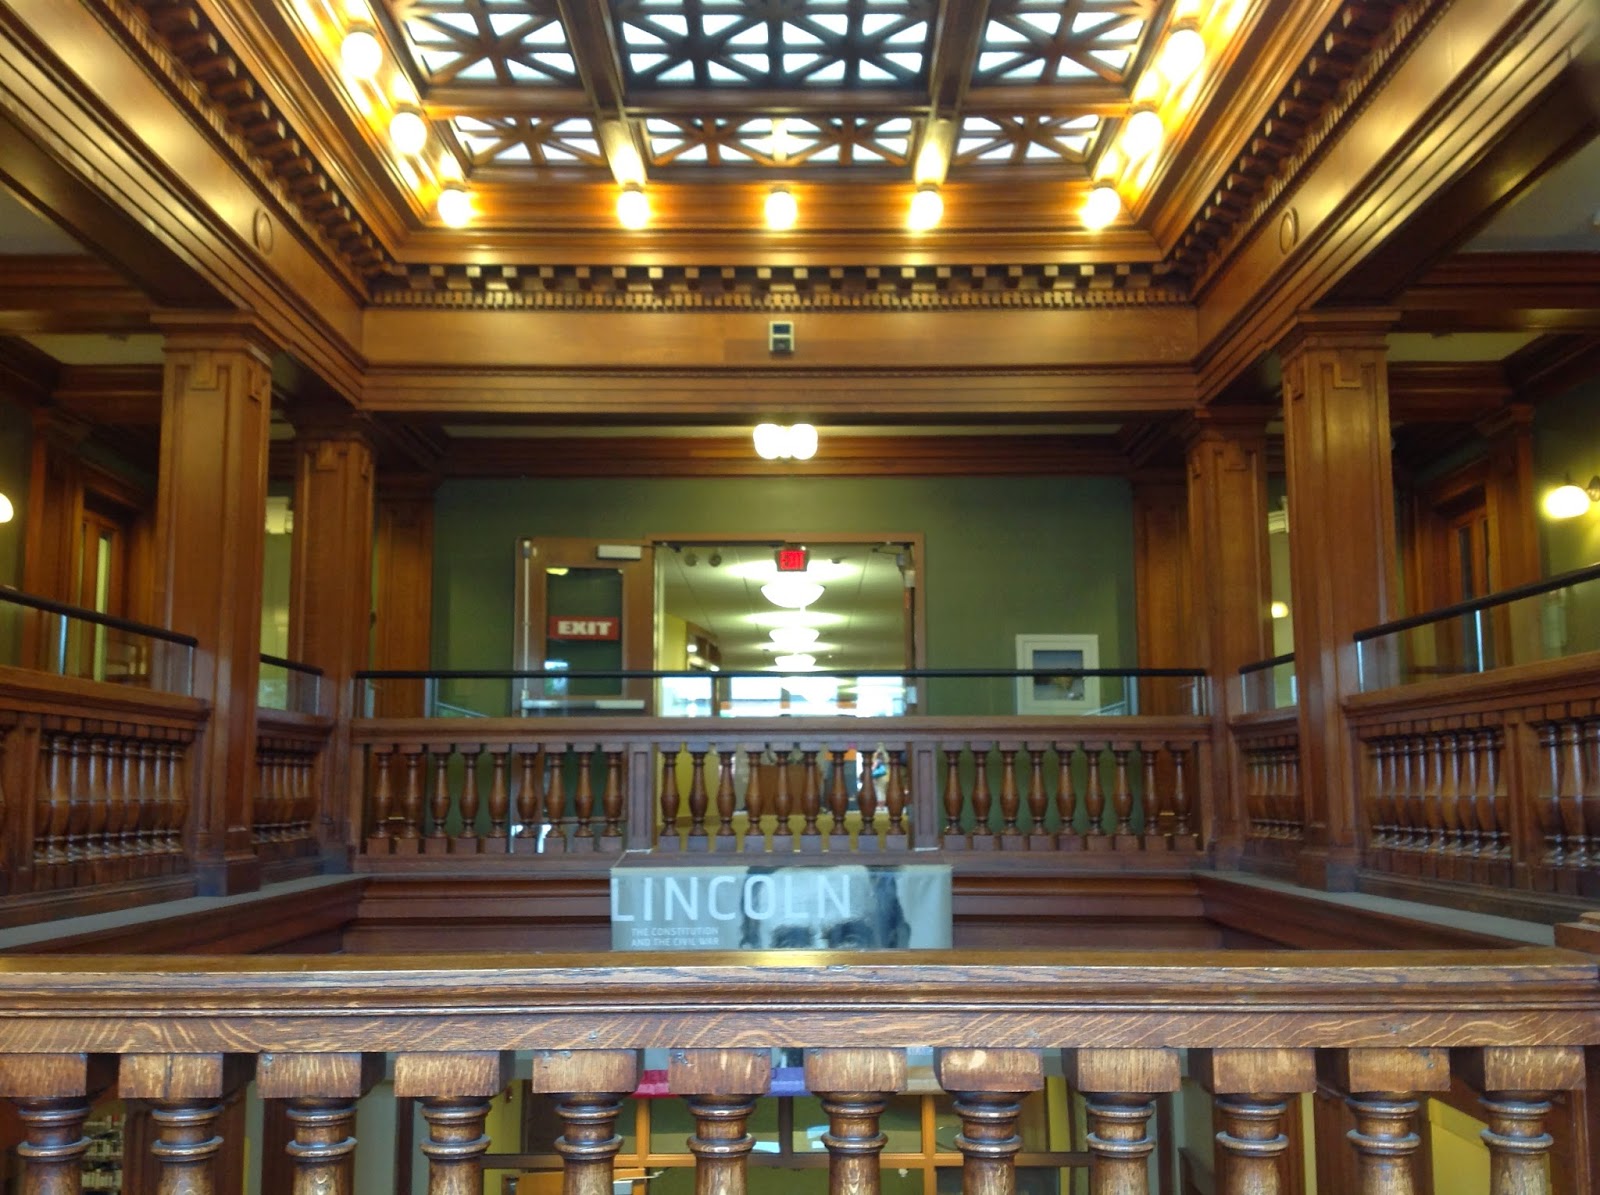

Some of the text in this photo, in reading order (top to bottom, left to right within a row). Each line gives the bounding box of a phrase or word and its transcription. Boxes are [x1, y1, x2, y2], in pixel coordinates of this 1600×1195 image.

[558, 621, 612, 635] EXIT
[611, 874, 850, 921] LINCOLN
[632, 927, 719, 936] THE CONSTITUTION
[631, 938, 651, 947] AND
[653, 938, 671, 946] THE
